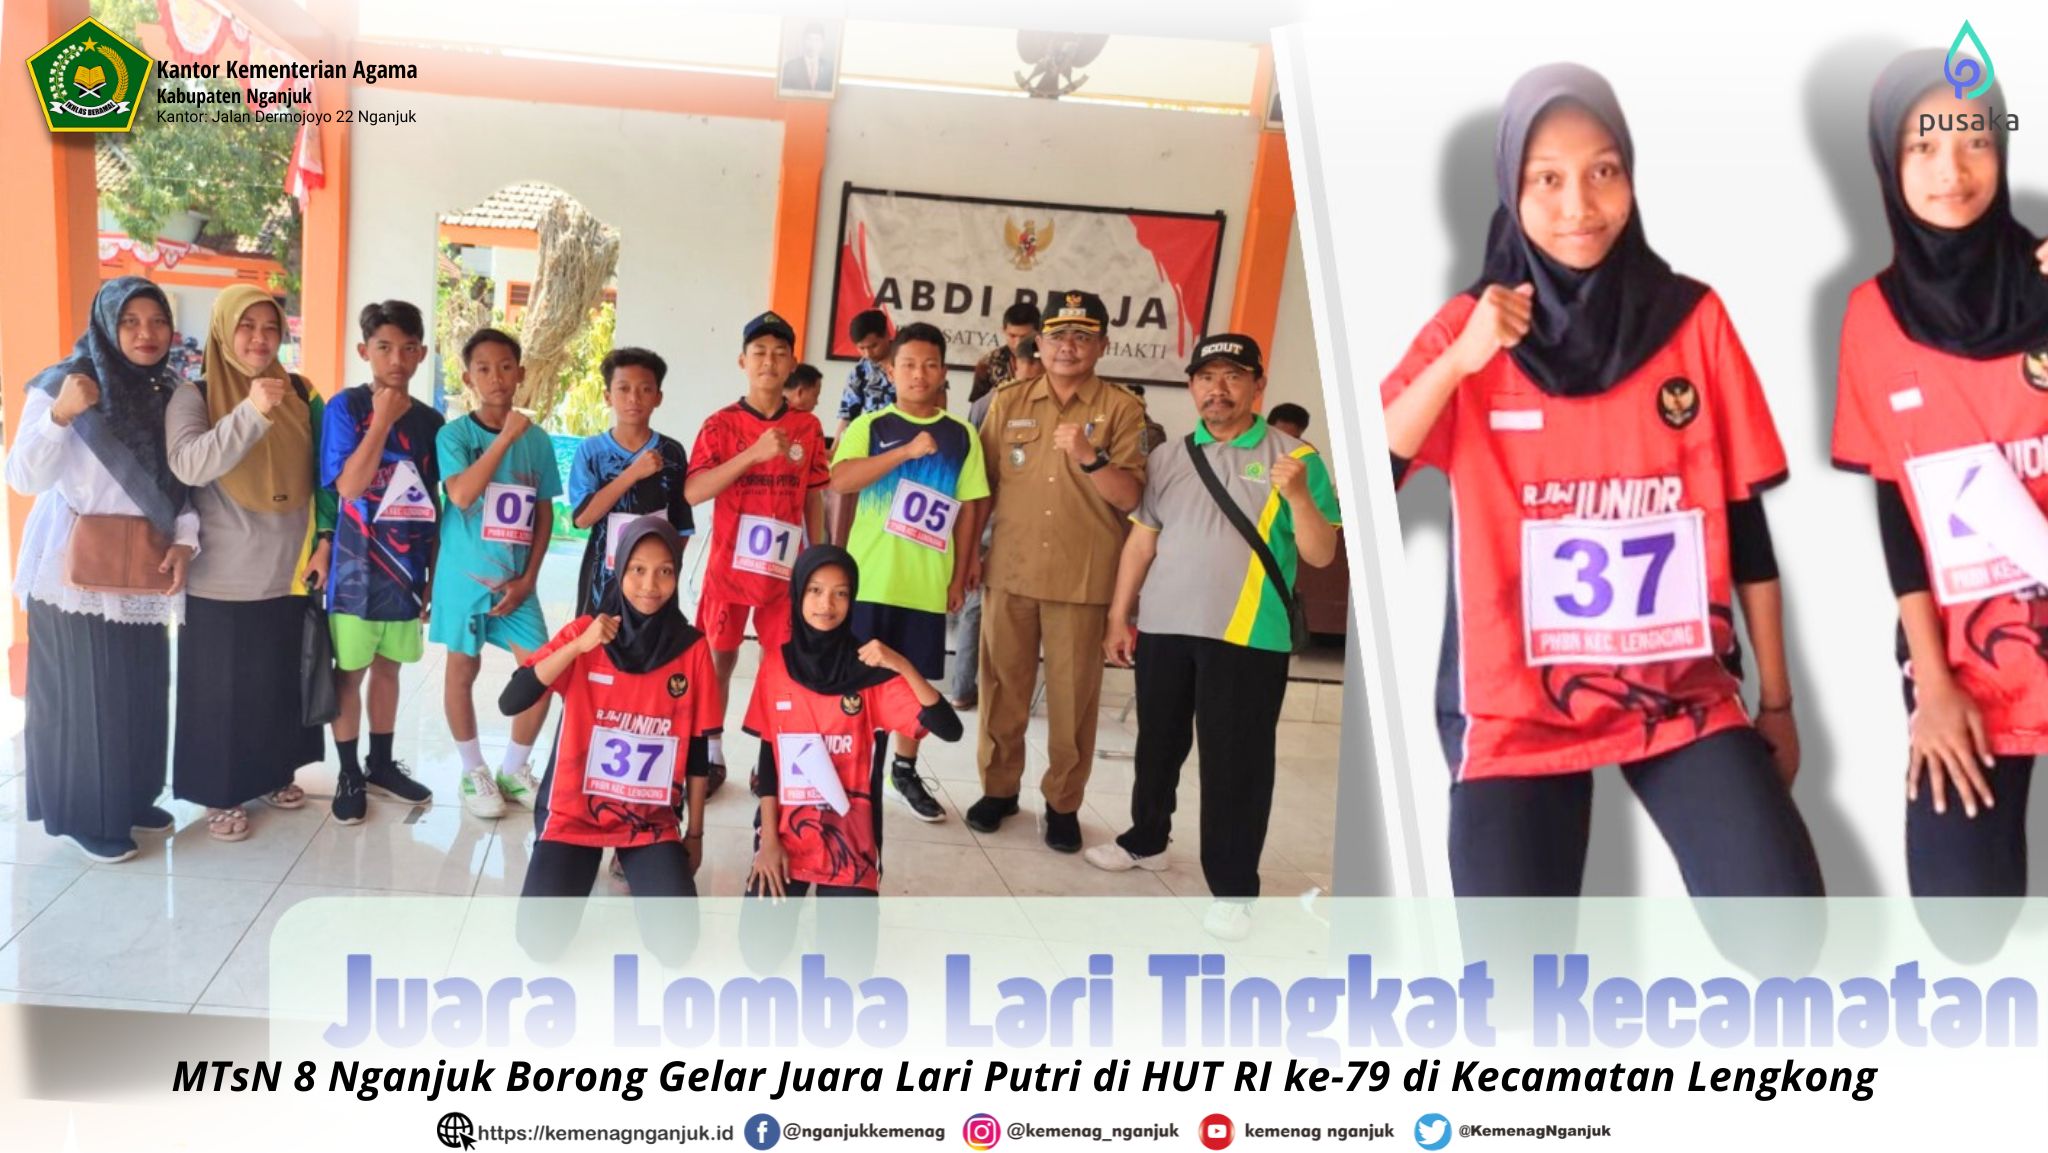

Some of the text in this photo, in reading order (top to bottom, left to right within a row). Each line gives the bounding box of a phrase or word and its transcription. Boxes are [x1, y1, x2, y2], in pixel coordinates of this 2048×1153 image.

[873, 277, 1167, 329] ABDI PJA
[943, 329, 1168, 361] SATYA HAKTI
[1201, 341, 1243, 357] SCOUT
[904, 491, 950, 532] 05
[749, 524, 790, 561] 01
[1554, 532, 1675, 617] 37
[601, 738, 664, 782] 37
